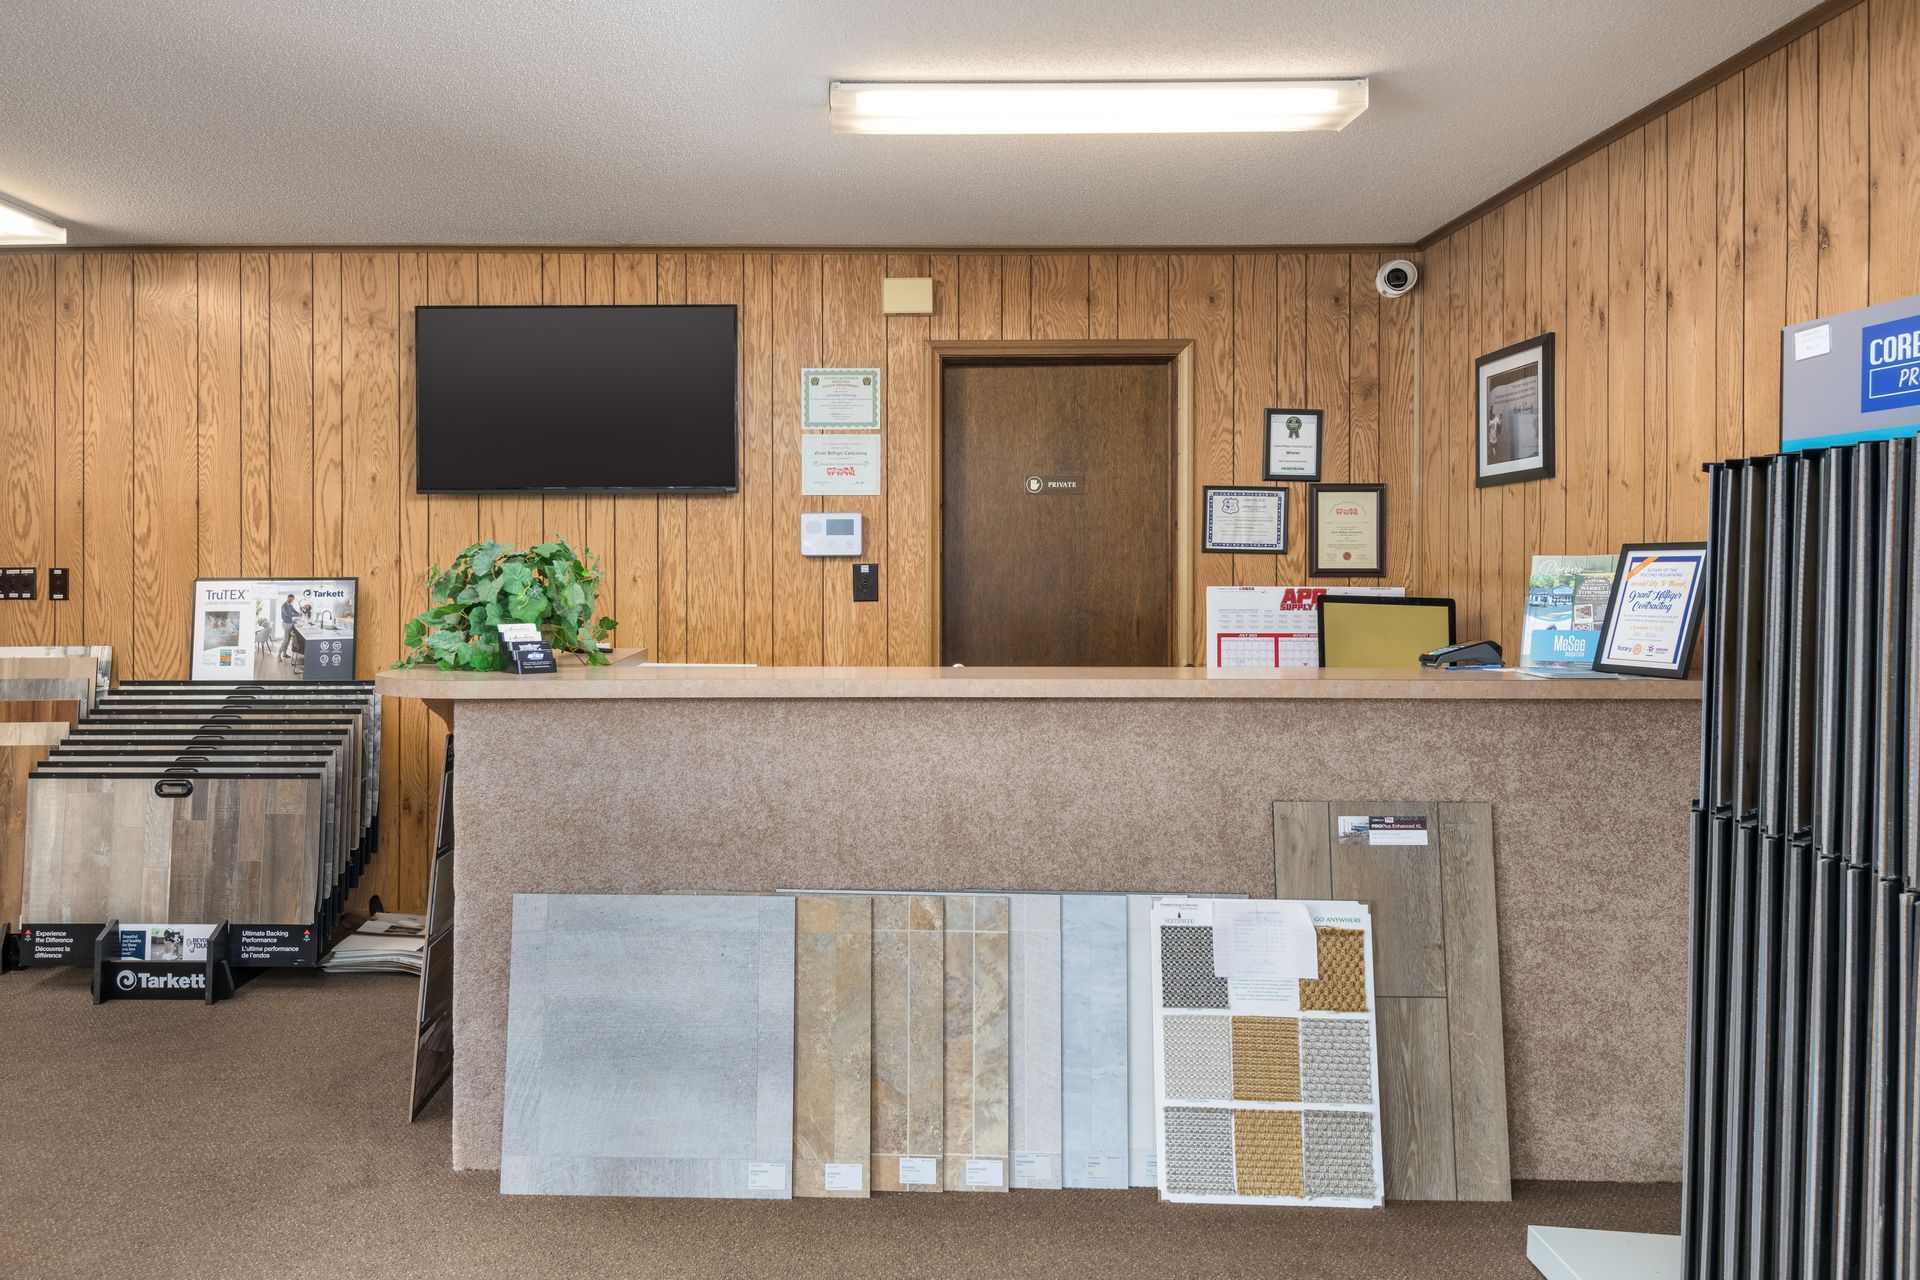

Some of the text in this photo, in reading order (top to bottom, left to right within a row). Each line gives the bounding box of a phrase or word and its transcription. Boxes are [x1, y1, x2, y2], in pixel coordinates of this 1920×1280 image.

[1898, 366, 1920, 388] PR
[205, 589, 246, 600] TruTEX
[313, 589, 344, 598] Tarkett
[1280, 603, 1313, 611] SUPPLY
[1631, 601, 1673, 613] Contracting
[1553, 635, 1586, 652] MeSee
[1617, 644, 1632, 652] Rotary
[36, 930, 67, 938] Experience
[266, 930, 289, 938] Backing
[264, 945, 299, 953] performance
[138, 972, 206, 989] Tarkett
